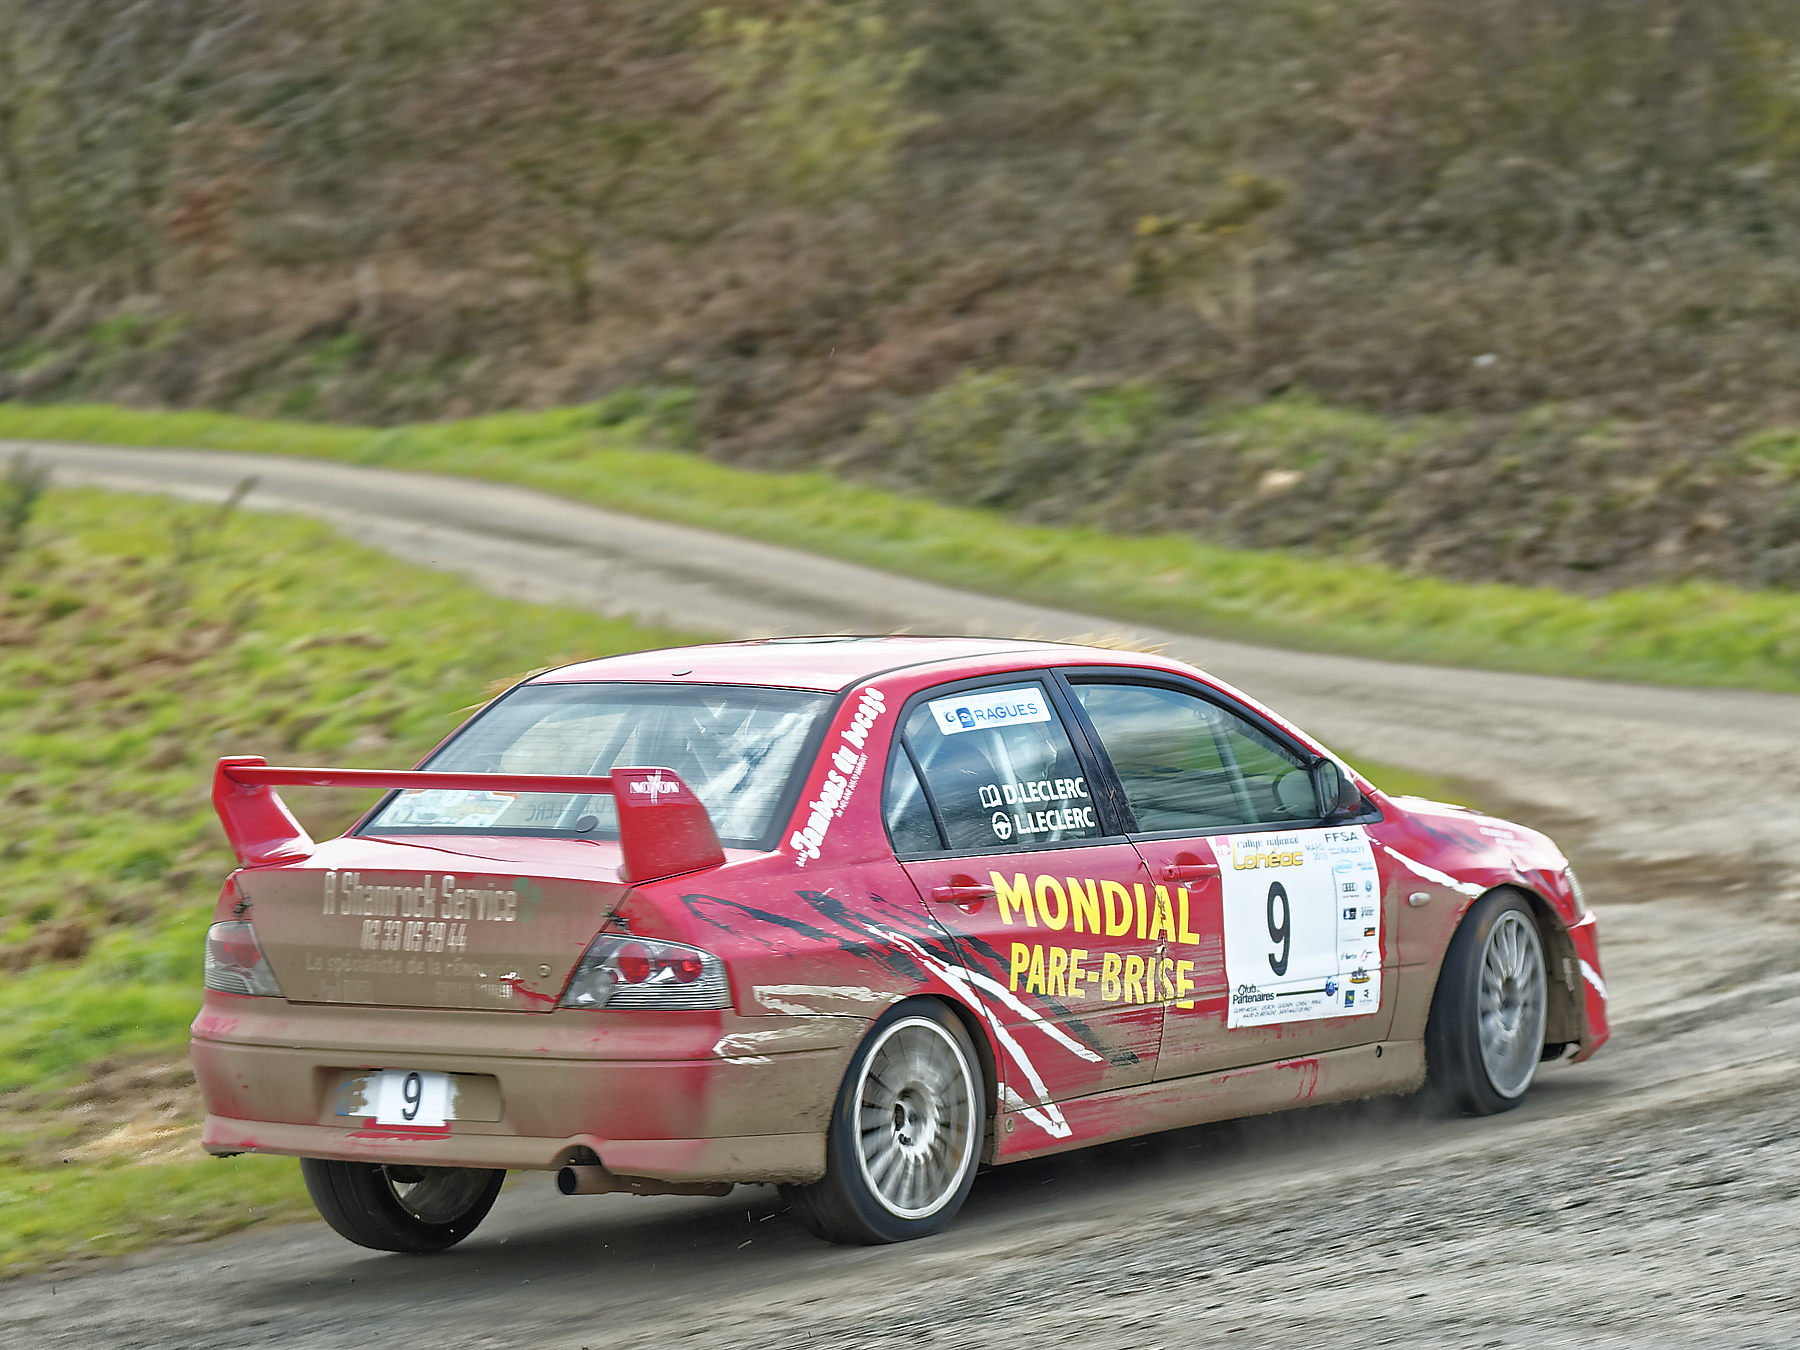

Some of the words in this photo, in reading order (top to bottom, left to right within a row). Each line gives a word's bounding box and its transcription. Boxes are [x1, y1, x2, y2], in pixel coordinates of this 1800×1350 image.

[974, 703, 1038, 721] RAGUES
[789, 769, 847, 859] Jambons
[832, 745, 860, 774] du
[1002, 777, 1088, 805] D.LECLERC
[1014, 807, 1095, 835] L.LECLERC
[1324, 831, 1359, 843] FFSA
[1232, 841, 1304, 871] Lohéac
[340, 872, 436, 918] Shamrock
[441, 874, 518, 922] Service
[989, 871, 1200, 945] MONDIAL
[1266, 881, 1291, 977] 9
[1009, 942, 1195, 1009] PARE-BRISE
[1232, 992, 1275, 1005] Partenaires
[402, 1071, 422, 1121] 9
